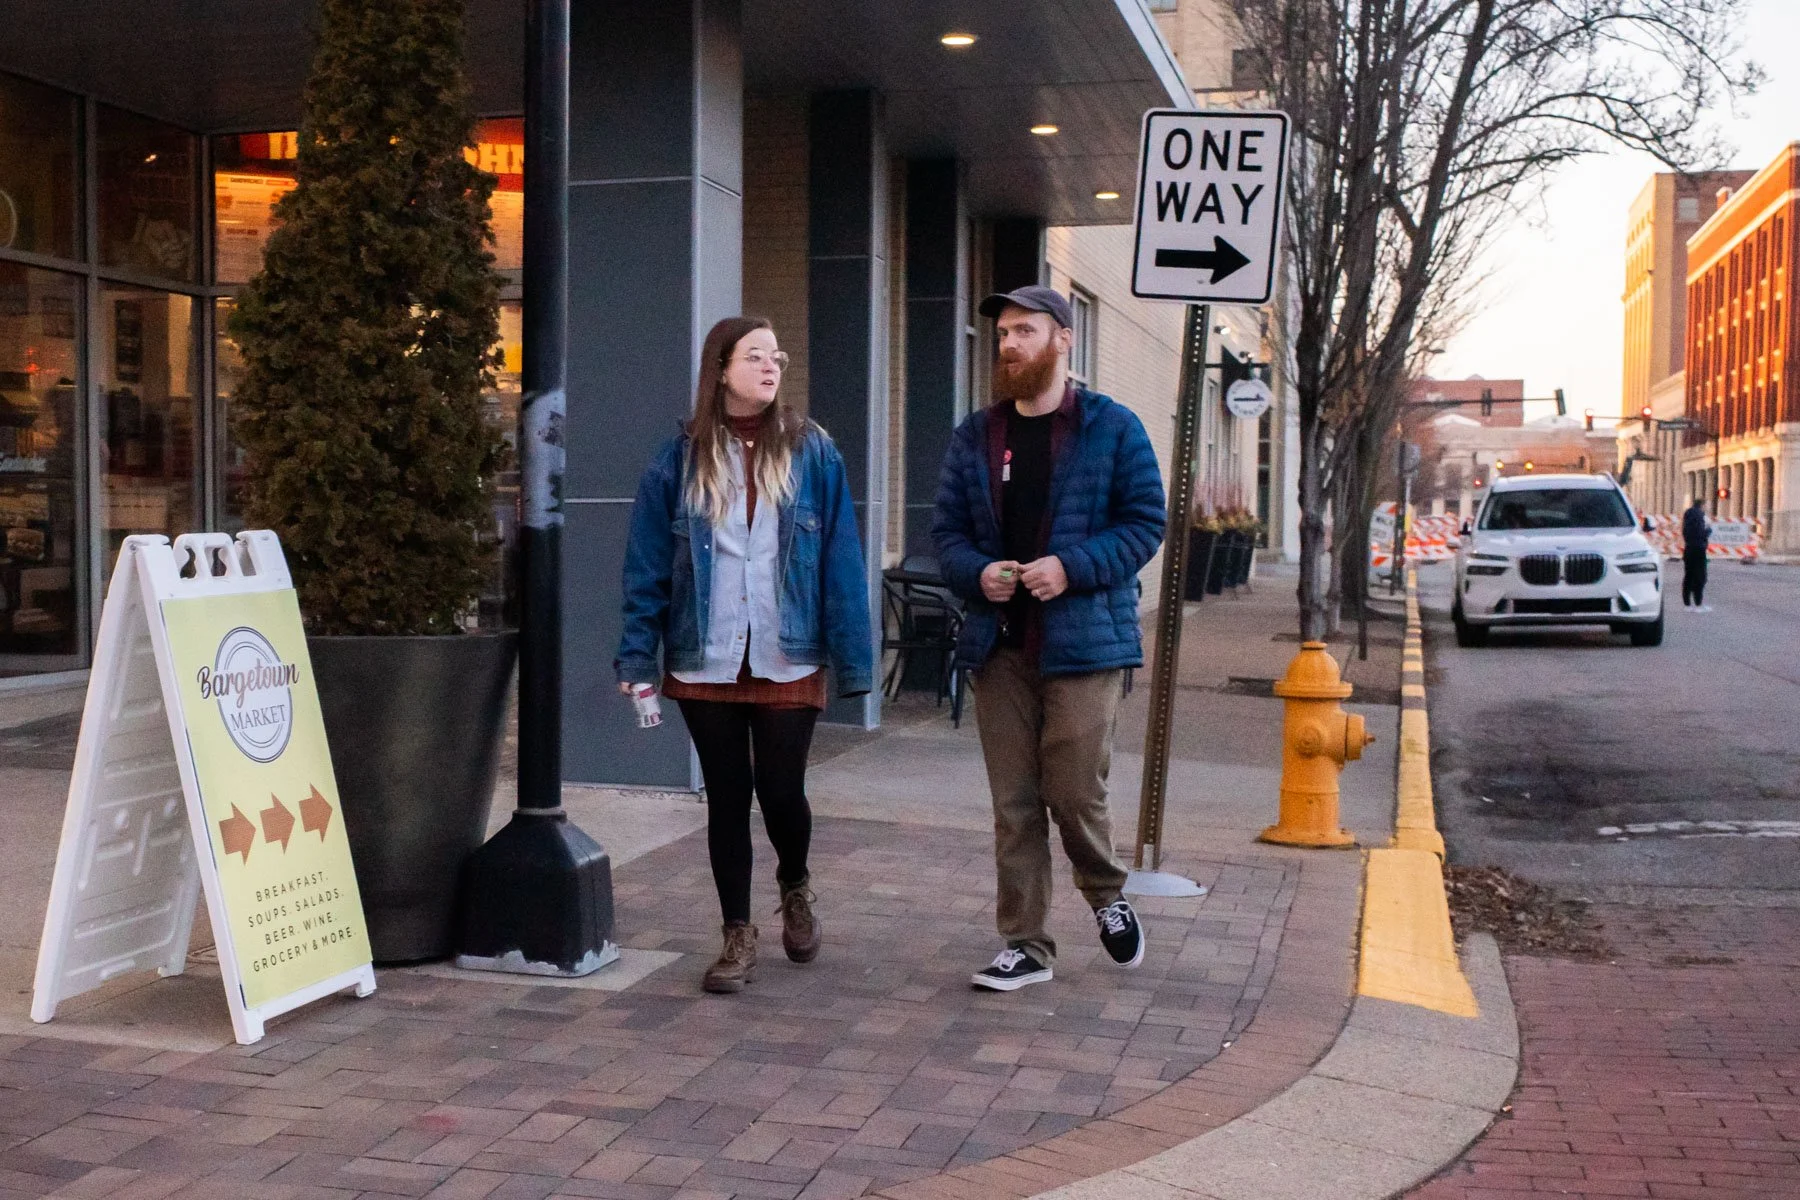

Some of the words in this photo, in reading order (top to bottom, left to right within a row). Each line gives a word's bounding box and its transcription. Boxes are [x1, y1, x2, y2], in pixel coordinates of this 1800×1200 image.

[1163, 128, 1265, 172] ONE
[1156, 181, 1265, 225] WAY
[197, 657, 299, 709] Bargetown
[230, 704, 287, 731] MARKET
[255, 871, 328, 902] BREAKFAST.
[248, 905, 292, 928] SOUPS.
[295, 888, 344, 912] SALADS.
[264, 925, 300, 945] BEER.
[303, 911, 337, 931] WINE.
[253, 942, 308, 972] GROCERY
[312, 939, 318, 951] &
[322, 926, 357, 947] MORE.
